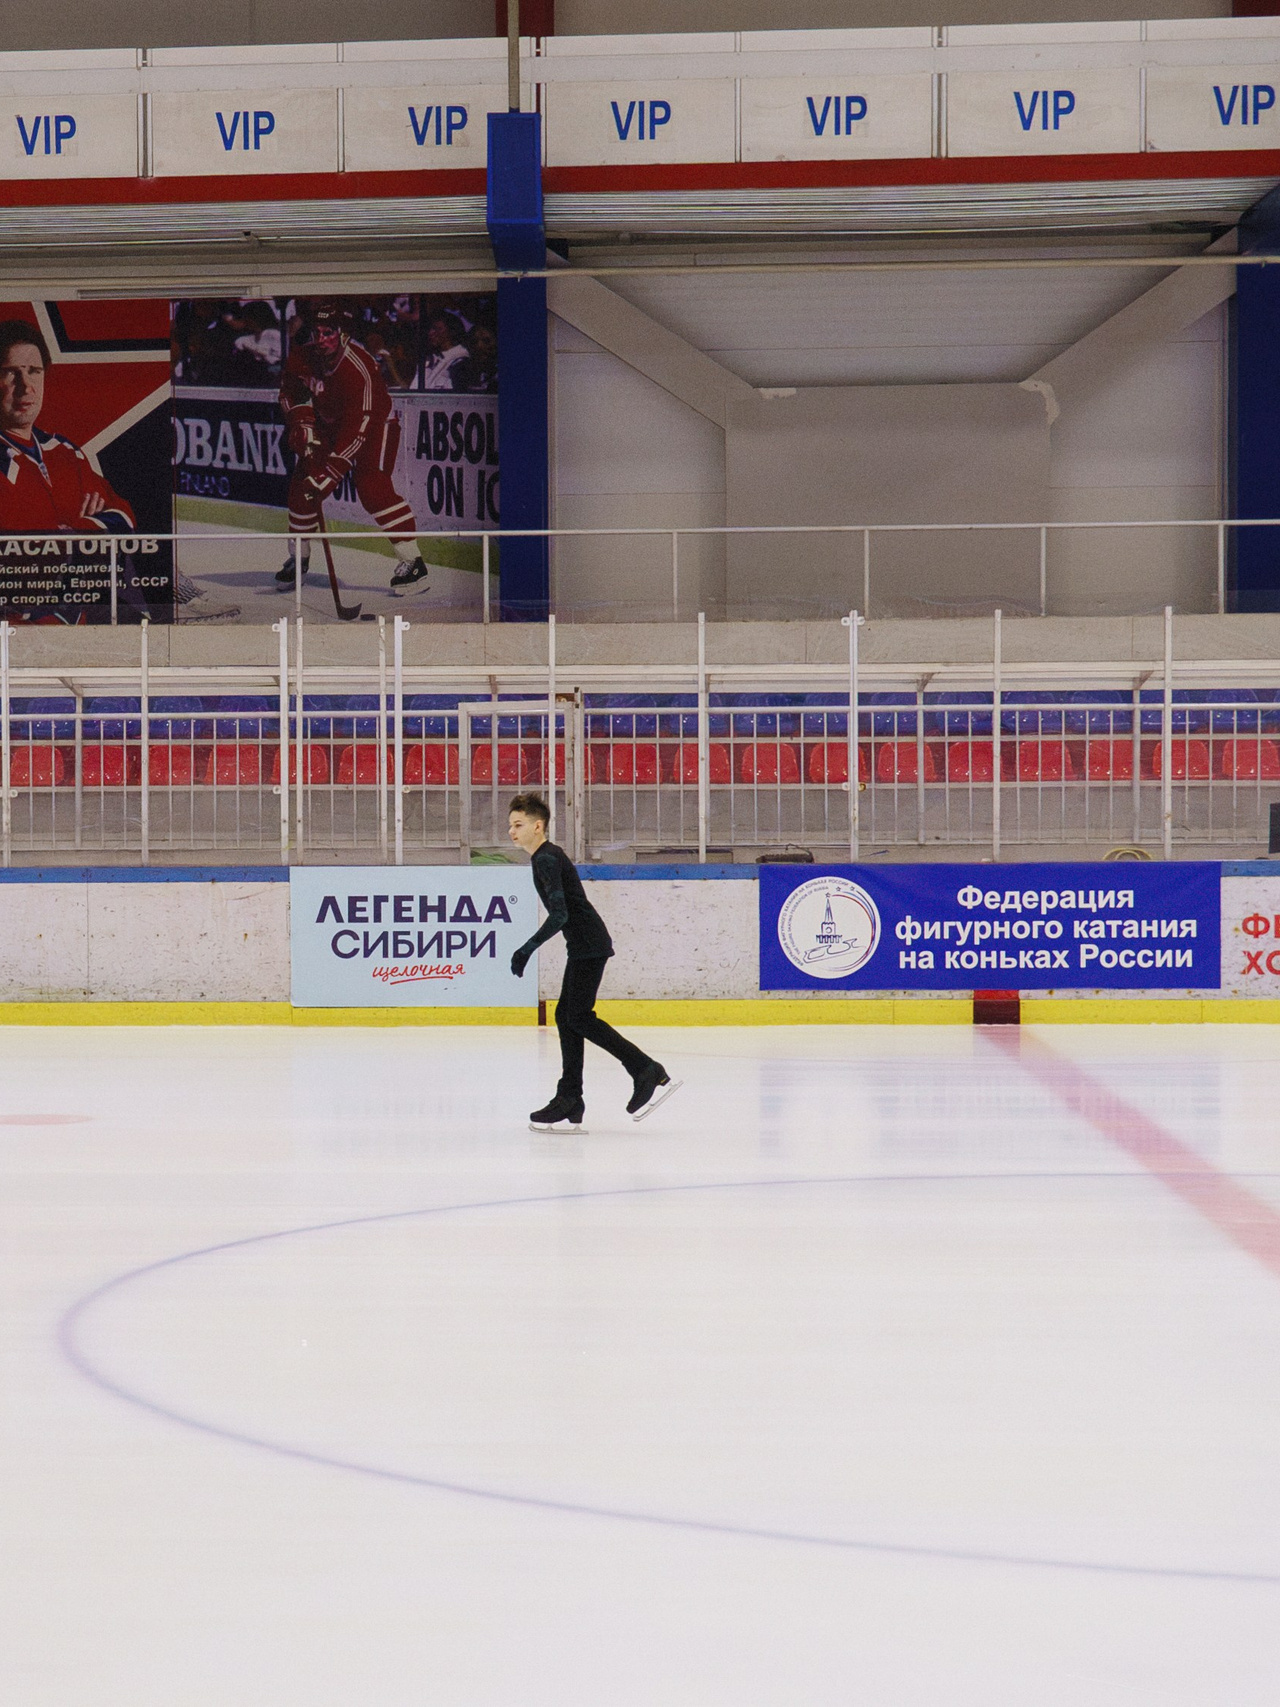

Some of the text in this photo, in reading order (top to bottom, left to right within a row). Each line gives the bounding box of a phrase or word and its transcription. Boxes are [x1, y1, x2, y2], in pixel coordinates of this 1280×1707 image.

[610, 100, 671, 140] VIP
[806, 95, 868, 136] VIP
[1014, 90, 1076, 131] VIP
[1212, 84, 1276, 126] VIP
[17, 114, 76, 156] VIP
[216, 110, 275, 151] VIP
[408, 105, 468, 145] VIP
[427, 464, 464, 518] ON
[12, 595, 59, 605] спорта
[63, 593, 101, 603] СССР
[27, 579, 66, 590] мира,
[131, 577, 169, 587] СССР
[315, 895, 512, 923] ЛЕГЕНДА
[957, 885, 1134, 915] Федерация
[895, 915, 1197, 946] фигурного катания
[1242, 912, 1280, 939] Ф
[331, 929, 496, 959] СИБИРИ
[899, 944, 1193, 969] на коньках России
[372, 963, 466, 983] щелочная
